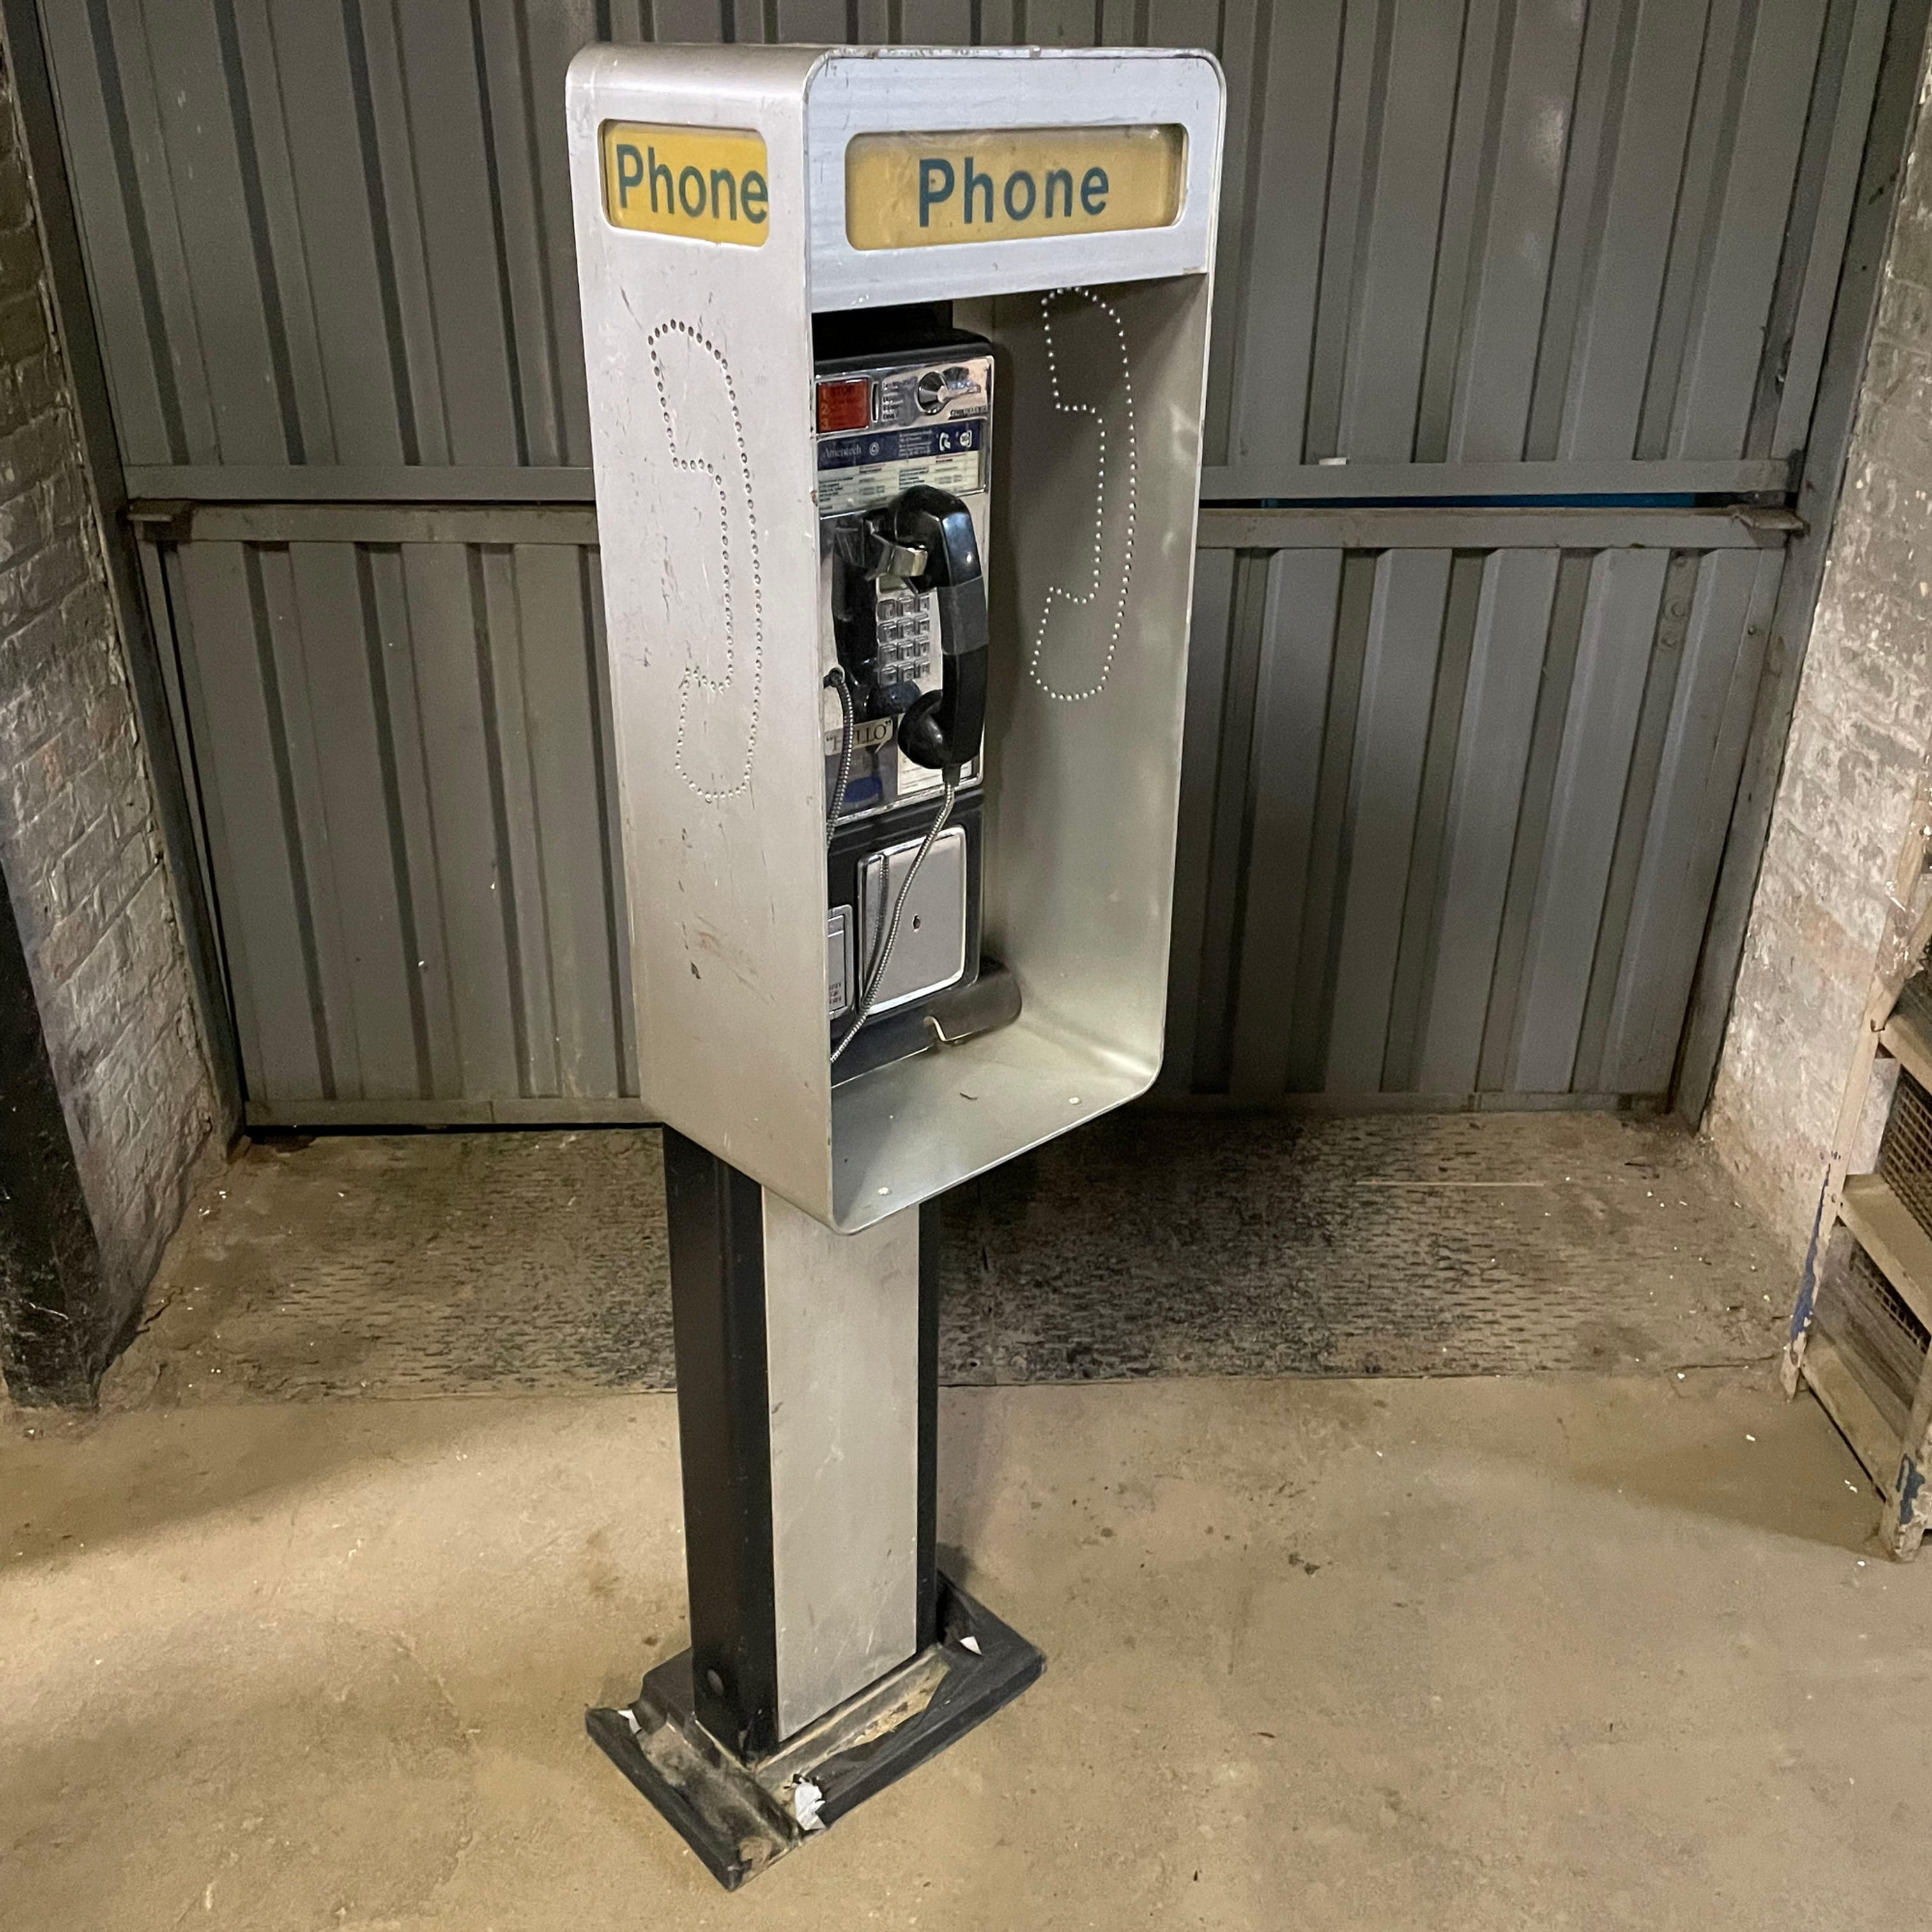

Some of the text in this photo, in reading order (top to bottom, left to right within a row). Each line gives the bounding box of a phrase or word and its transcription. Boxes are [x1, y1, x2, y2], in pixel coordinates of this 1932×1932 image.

[617, 144, 768, 224] Phone
[919, 157, 1108, 227] Phone
[820, 402, 829, 415] 2
